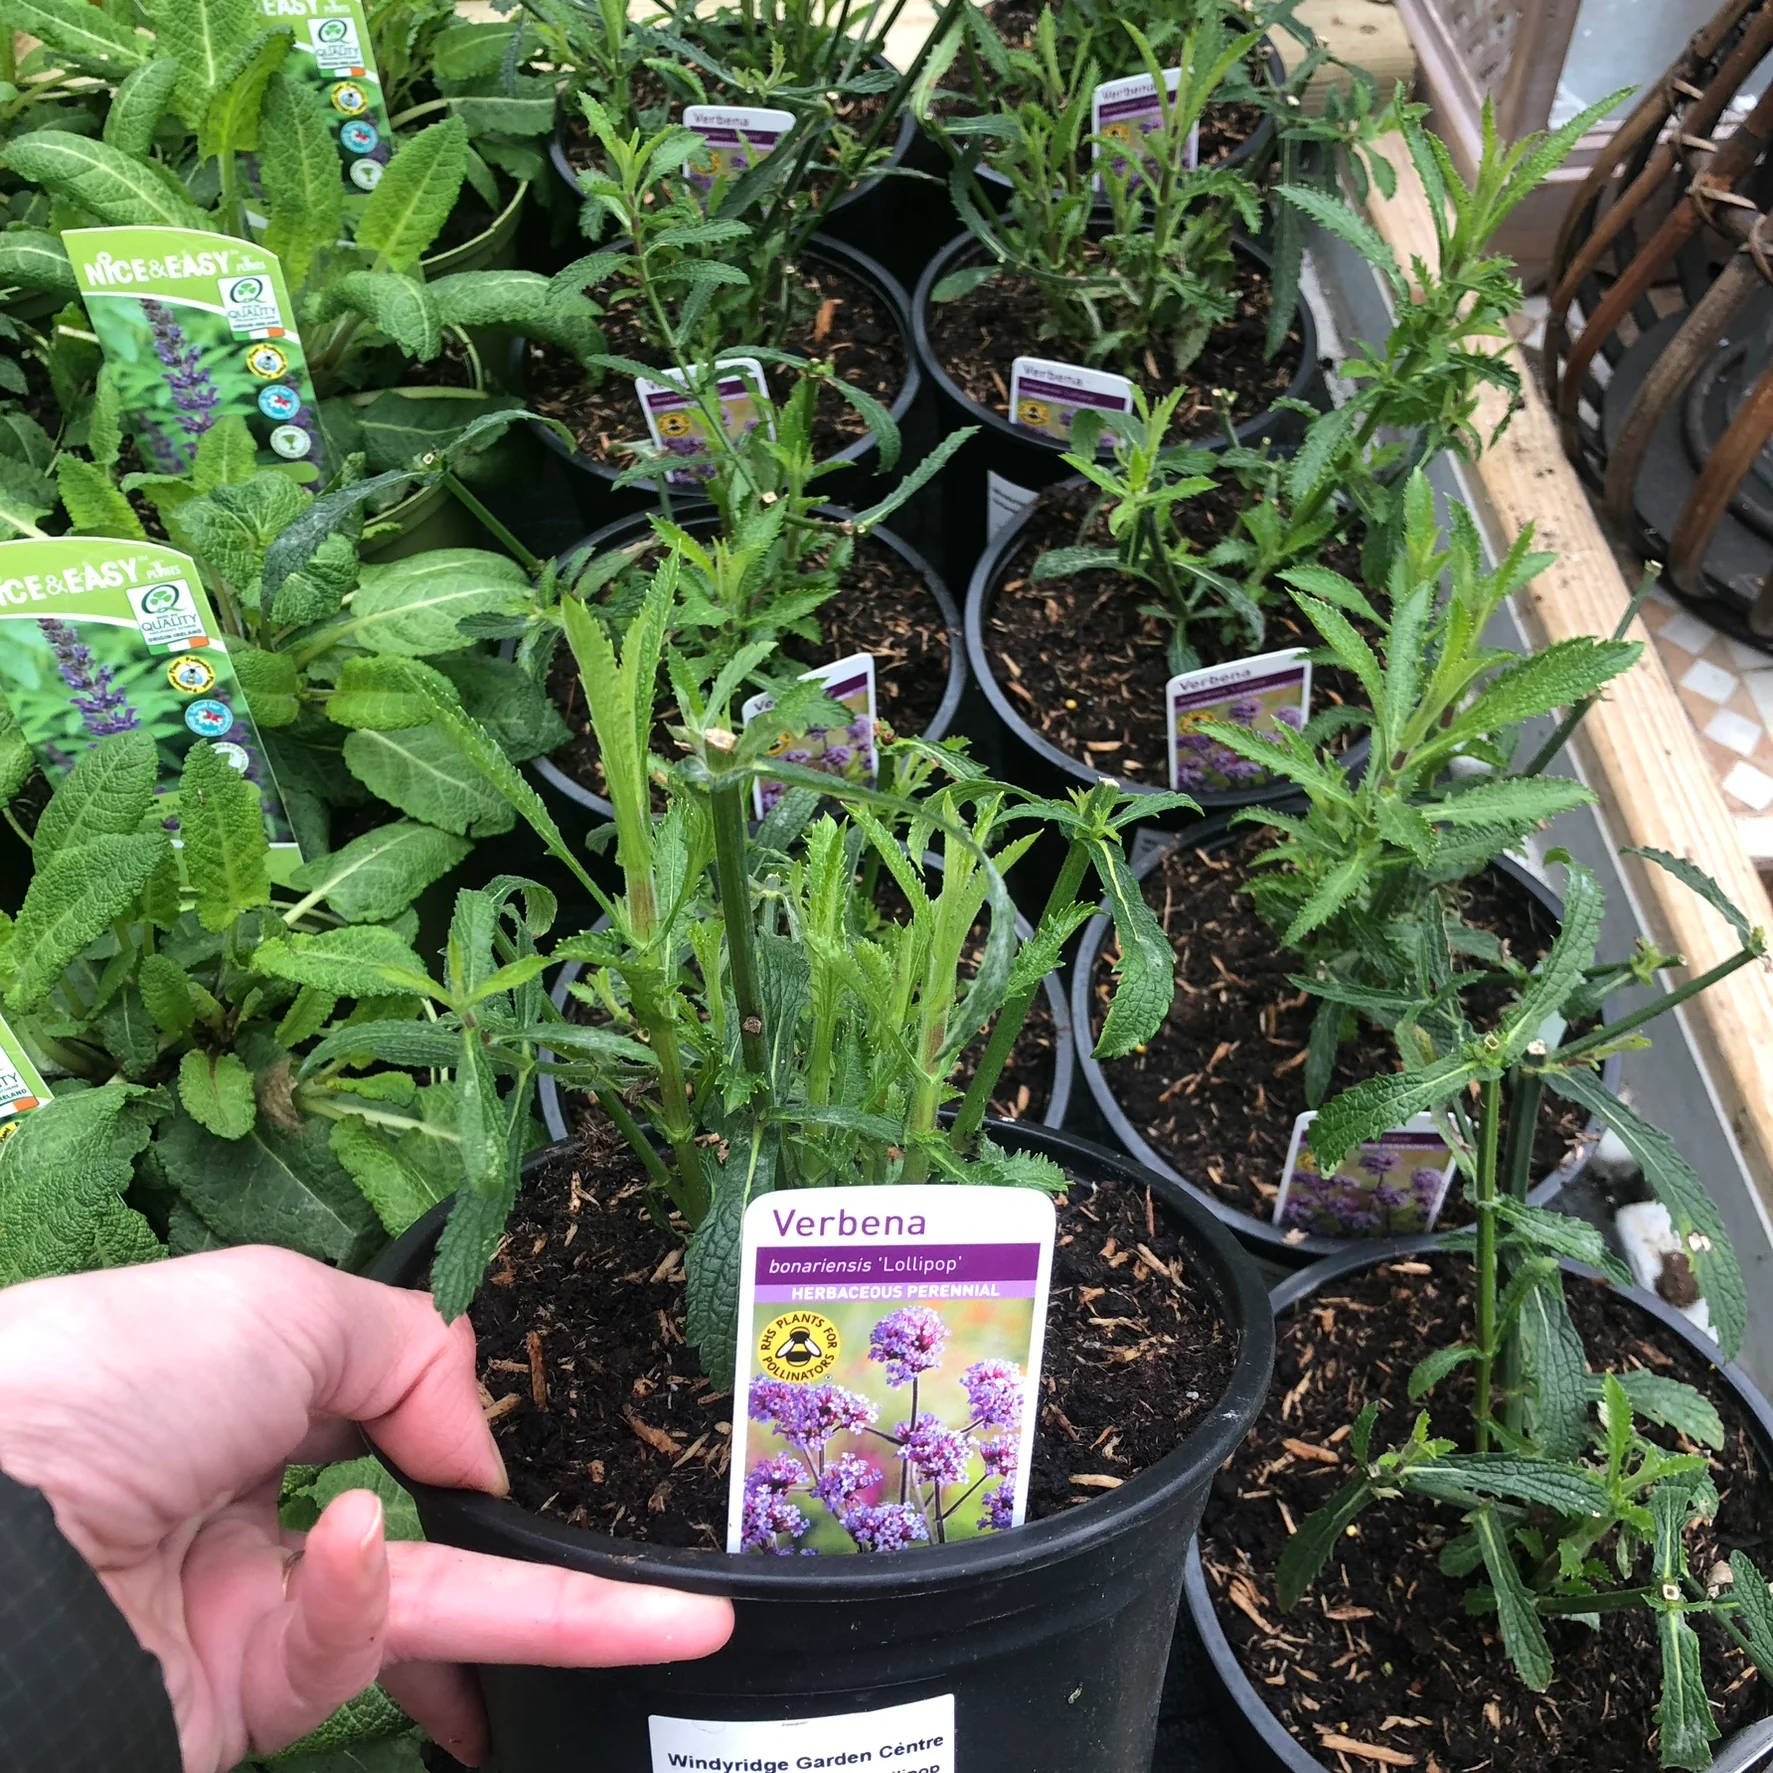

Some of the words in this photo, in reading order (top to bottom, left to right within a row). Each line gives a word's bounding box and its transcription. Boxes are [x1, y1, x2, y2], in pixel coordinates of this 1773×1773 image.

[141, 613, 197, 632] QUALITY
[1180, 669, 1251, 691] Verbena
[773, 1208, 927, 1237] Verbena
[768, 1258, 872, 1274] bonariensis
[878, 1255, 963, 1275] 'Lollipop'
[791, 1285, 903, 1300] HERBACEOUS
[906, 1283, 1000, 1298] PERENNIAL
[776, 1313, 825, 1328] PLANTS
[761, 1328, 776, 1350] RHS
[823, 1327, 838, 1349] FOR
[762, 1353, 835, 1381] POLLINATORS
[667, 1753, 789, 1773] Windyridge
[796, 1751, 872, 1770] Garden
